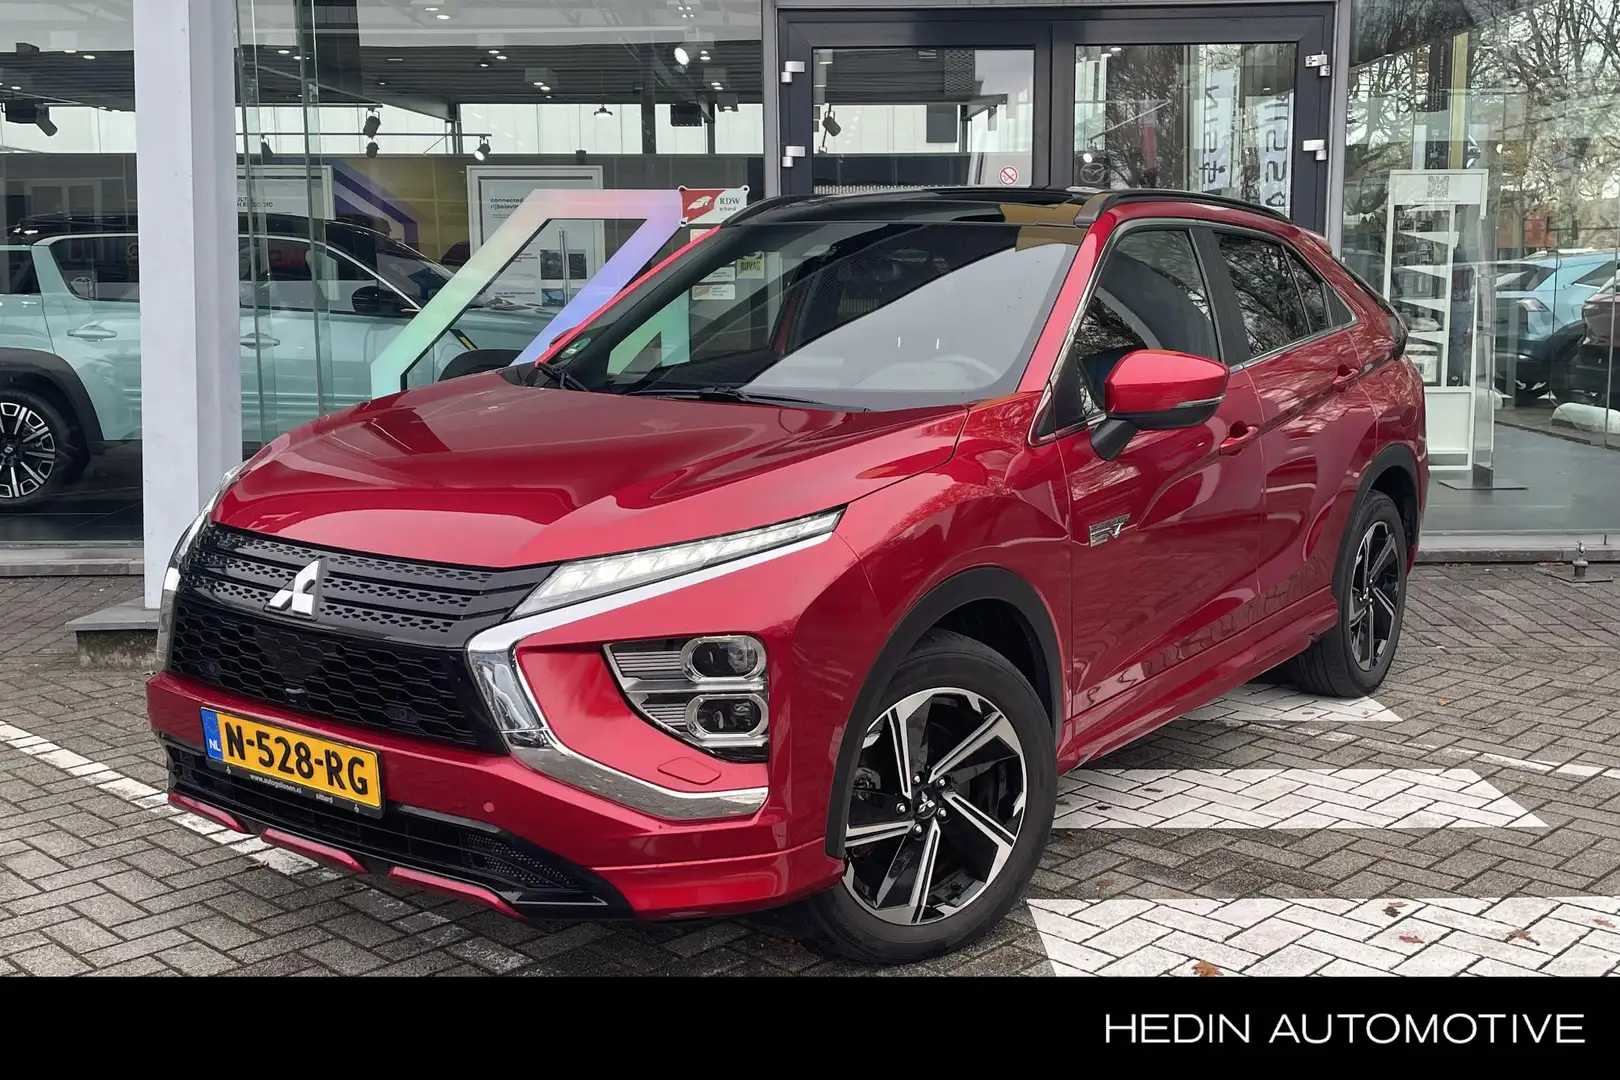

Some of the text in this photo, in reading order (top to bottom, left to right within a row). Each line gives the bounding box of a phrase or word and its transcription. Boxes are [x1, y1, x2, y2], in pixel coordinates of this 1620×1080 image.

[720, 197, 740, 205] RDW
[740, 260, 761, 272] BOVAG
[208, 738, 222, 752] NL
[224, 721, 369, 796] N-528-RG
